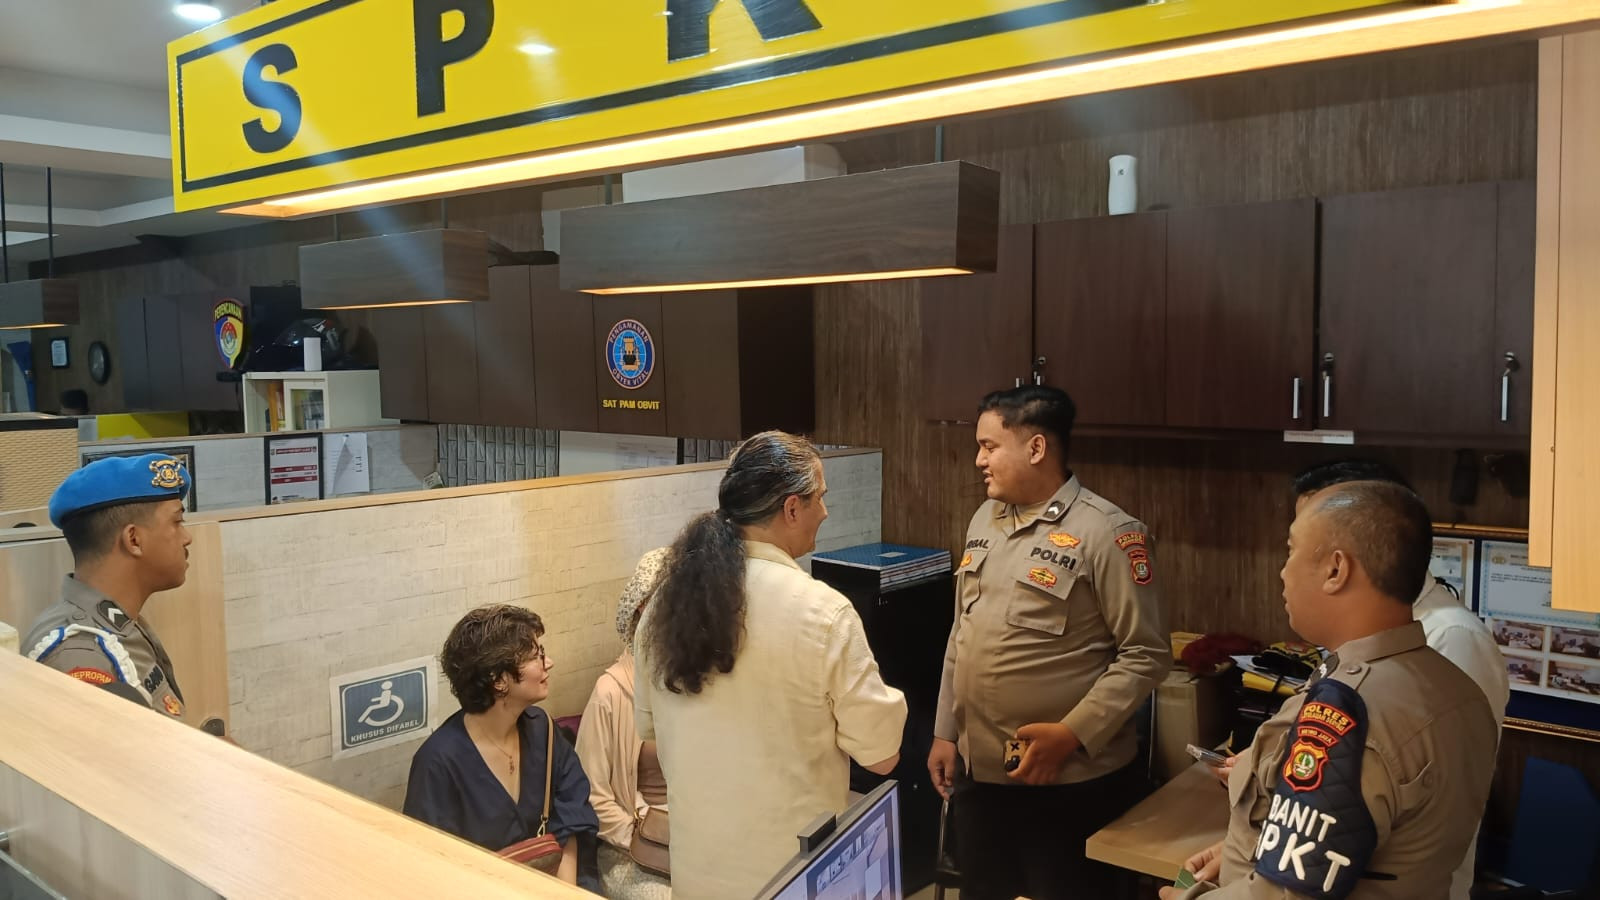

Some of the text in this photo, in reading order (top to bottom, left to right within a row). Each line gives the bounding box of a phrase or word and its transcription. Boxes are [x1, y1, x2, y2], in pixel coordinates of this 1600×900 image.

[633, 370, 649, 386] VITAL
[602, 399, 660, 410] SAT PAM OBVIT
[1030, 547, 1077, 570] POLRI
[350, 719, 420, 743] KHUSUS DIFABEL
[1268, 793, 1337, 842] BANIT
[1255, 820, 1351, 892] PKT
